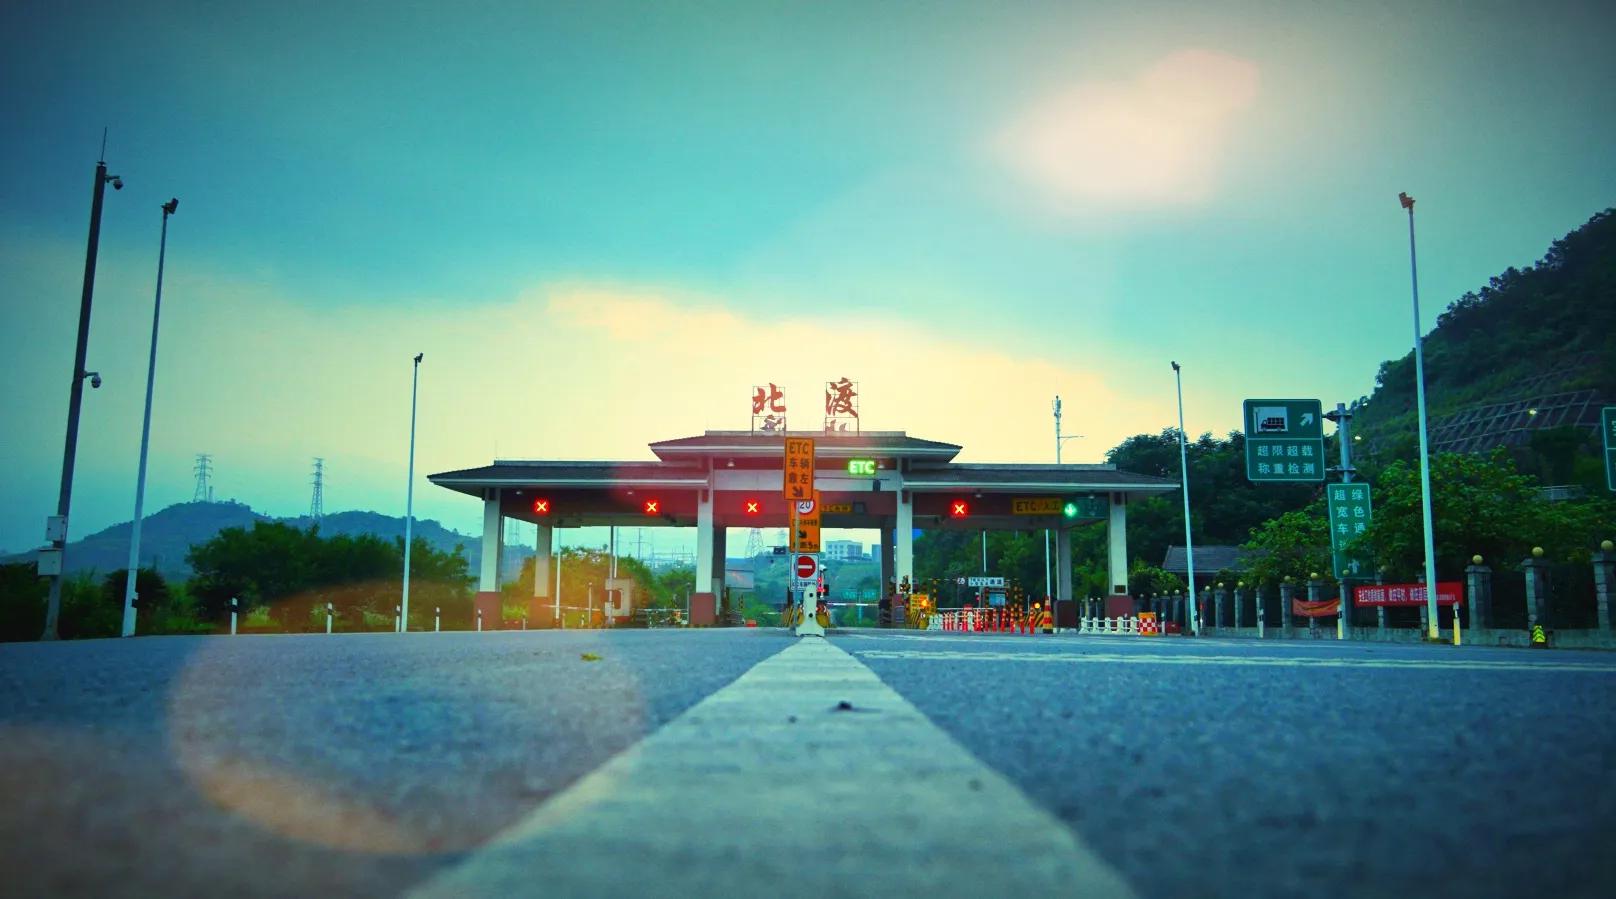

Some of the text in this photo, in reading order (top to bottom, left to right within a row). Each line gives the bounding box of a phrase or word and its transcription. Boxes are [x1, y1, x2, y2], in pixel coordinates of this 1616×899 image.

[789, 442, 809, 454] ETC
[1257, 445, 1314, 457] 超限超载
[789, 457, 809, 468] 车辆
[849, 460, 875, 474] ETC
[1257, 462, 1315, 475] 称重检测
[799, 500, 811, 509] 20
